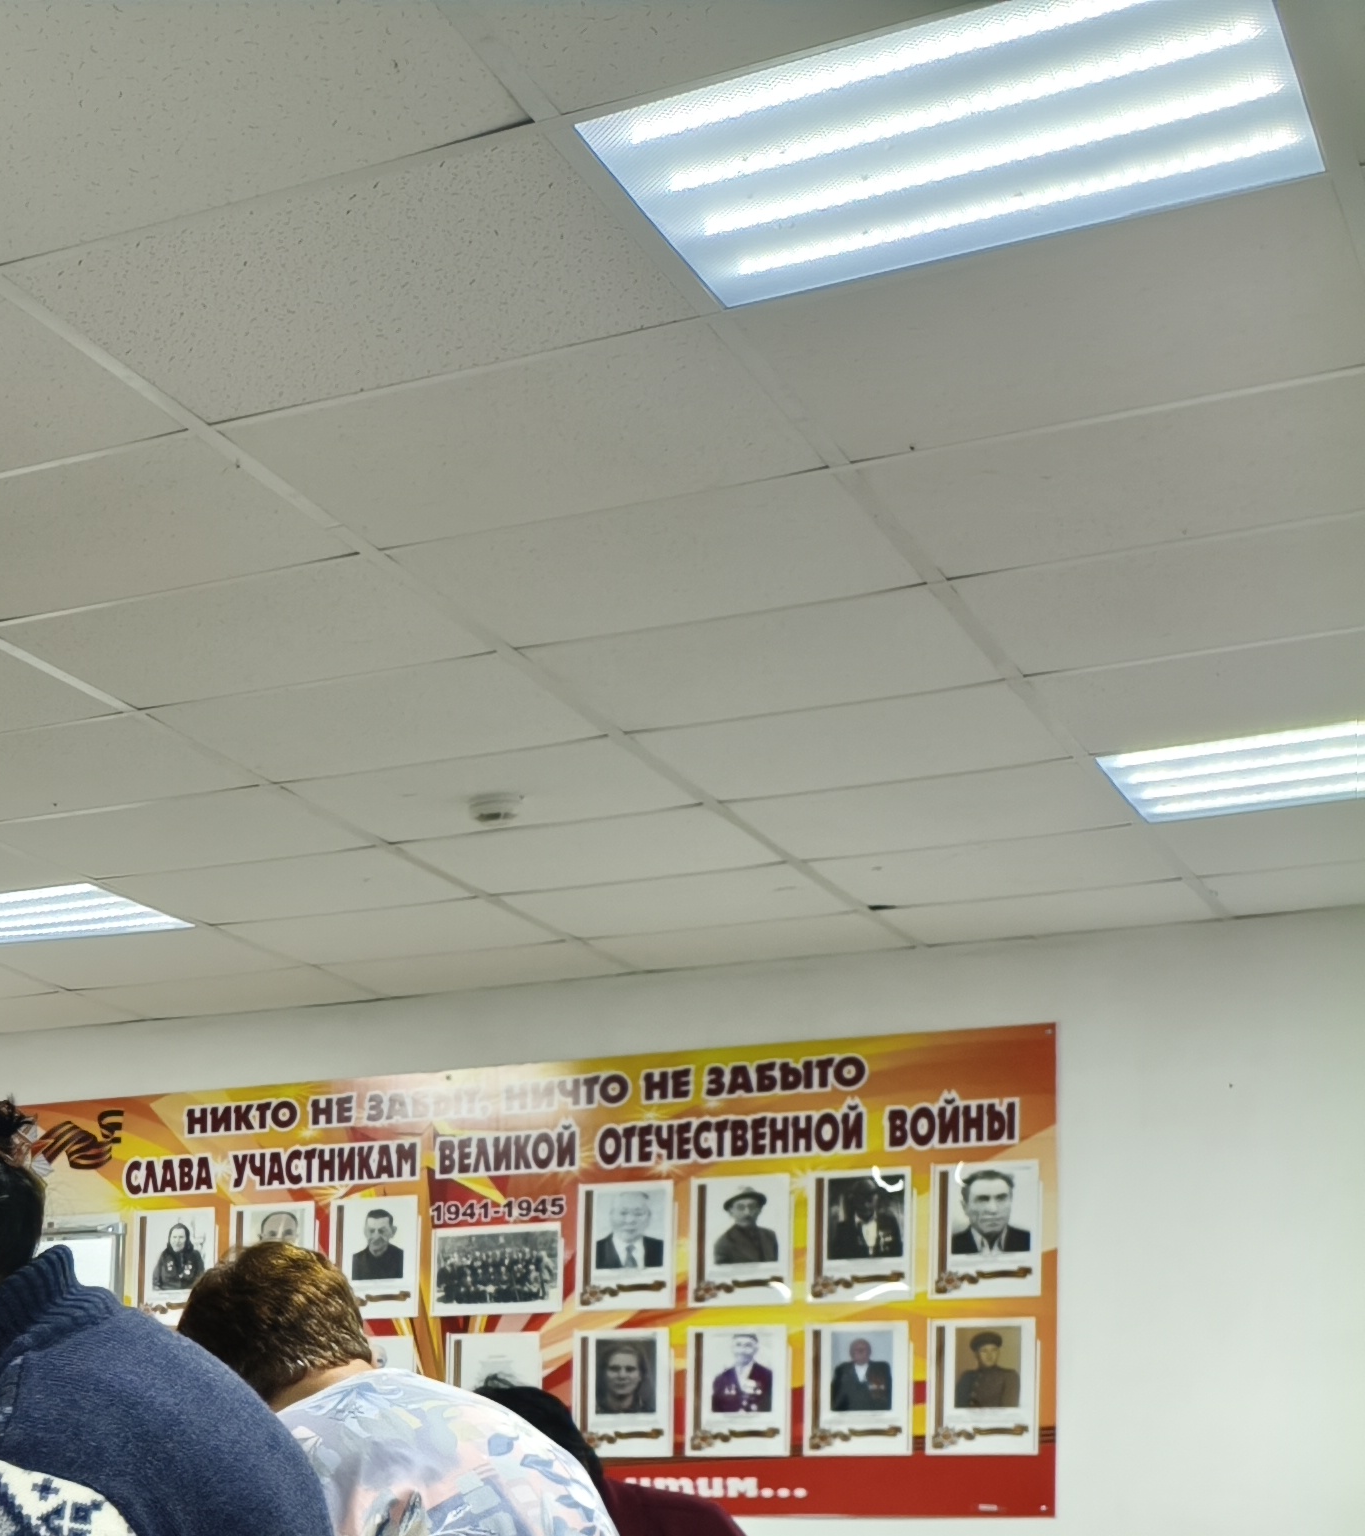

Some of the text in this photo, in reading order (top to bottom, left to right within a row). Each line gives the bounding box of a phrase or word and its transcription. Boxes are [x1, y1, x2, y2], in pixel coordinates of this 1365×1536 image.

[185, 1099, 299, 1136] НИКТО
[309, 1094, 355, 1126] НЕ
[504, 1074, 630, 1112] НИЧТО
[643, 1067, 692, 1101] НЕ
[705, 1055, 866, 1097] ЗАБЫТО
[125, 1096, 1016, 1195] СЛАВА УЧАСТНИКАМ ВЕЛИКОЙ ОТЕЧЕСТВЕННОЙ ВОЙНЫ
[431, 1197, 565, 1223] 1941-1945
